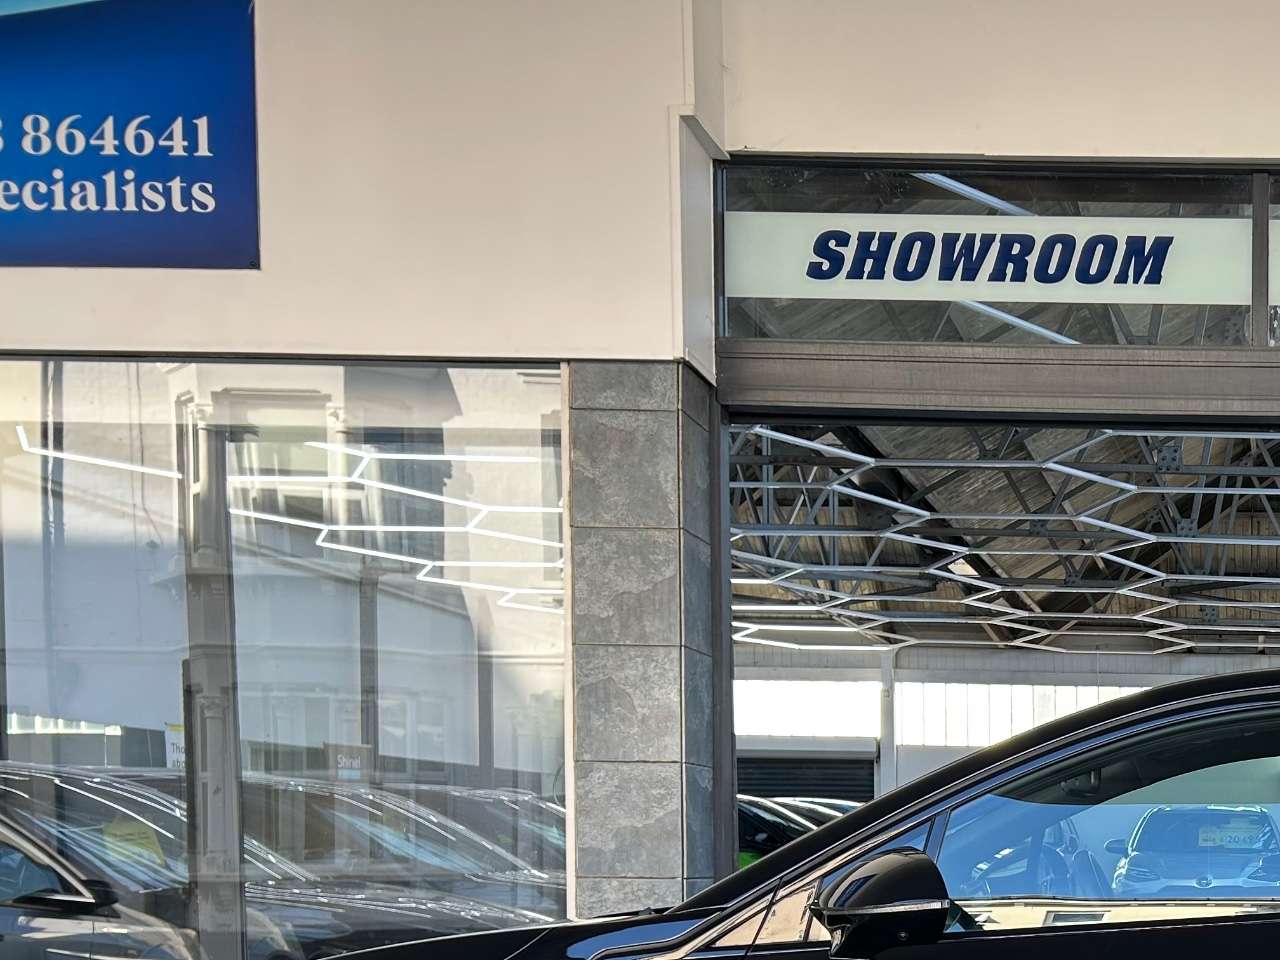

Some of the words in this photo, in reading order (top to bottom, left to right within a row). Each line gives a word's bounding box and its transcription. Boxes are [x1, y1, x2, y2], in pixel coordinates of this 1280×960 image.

[21, 114, 214, 157] 864641
[0, 168, 216, 213] ecialists
[806, 230, 1174, 285] SHOWROOM
